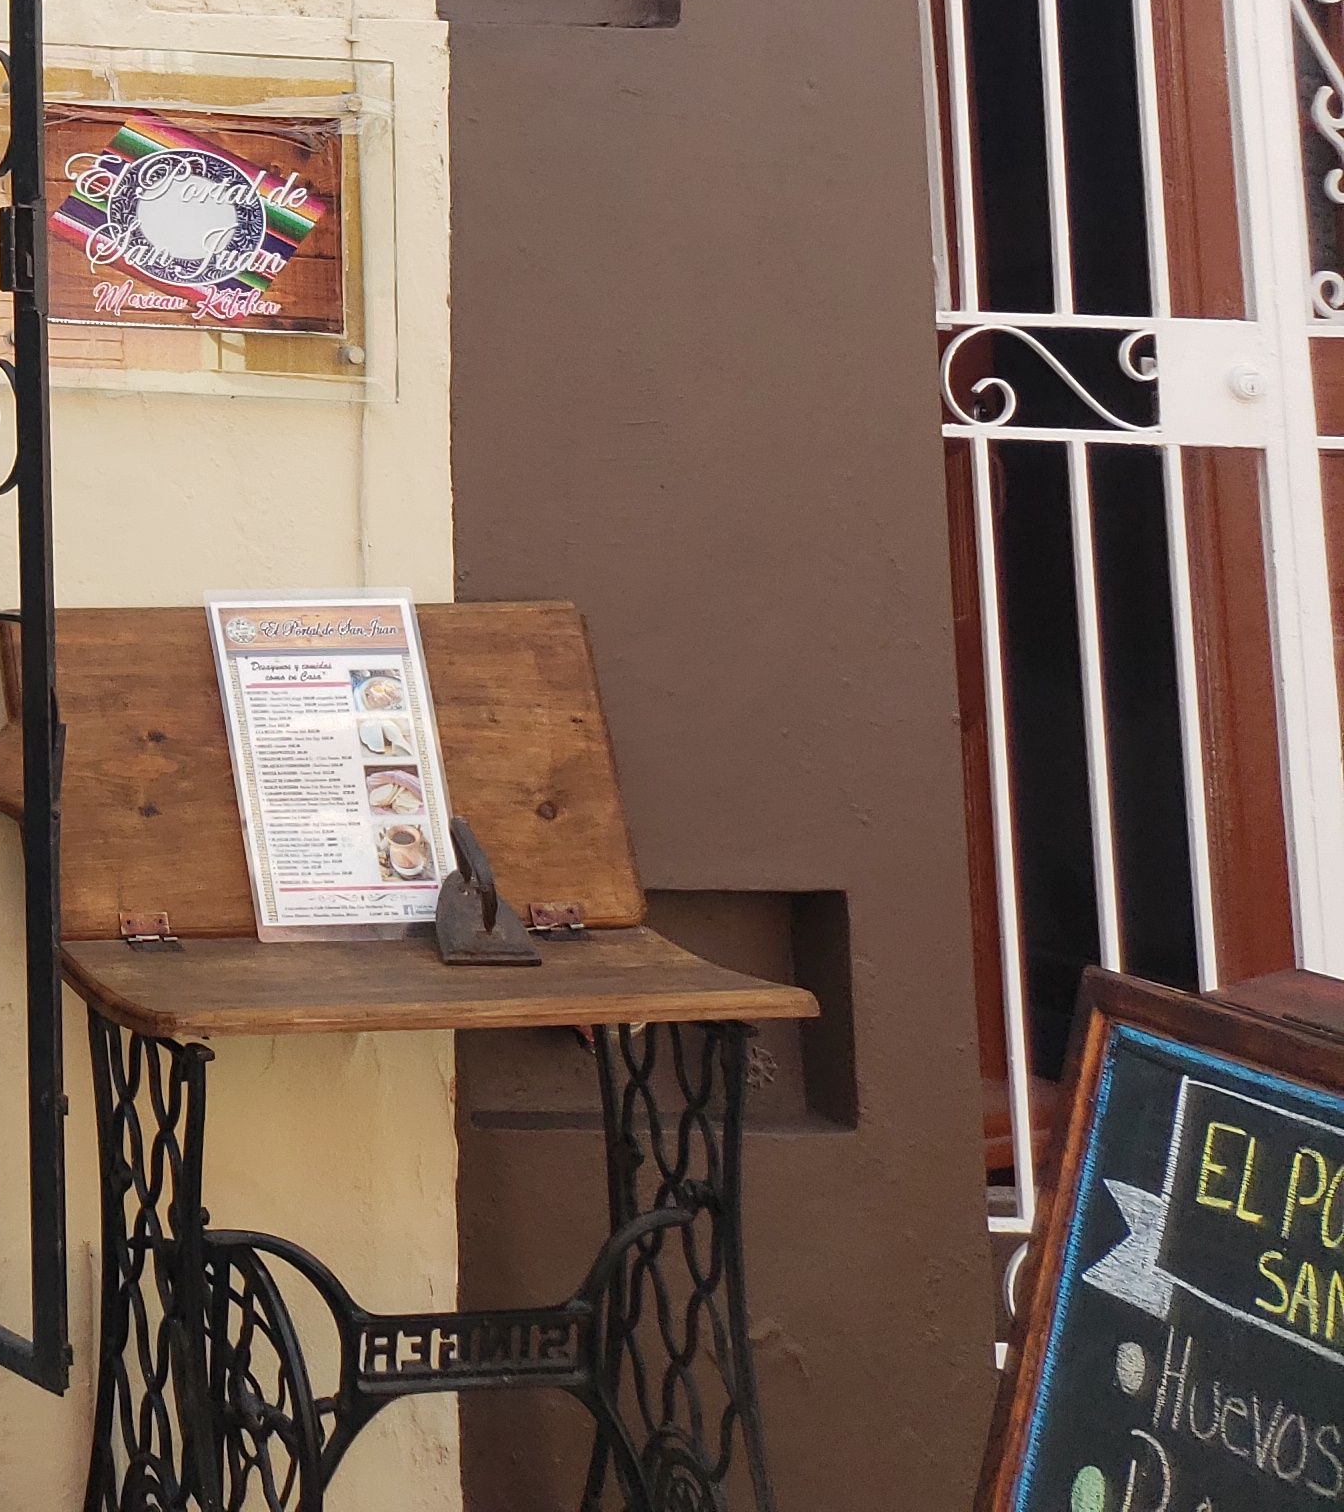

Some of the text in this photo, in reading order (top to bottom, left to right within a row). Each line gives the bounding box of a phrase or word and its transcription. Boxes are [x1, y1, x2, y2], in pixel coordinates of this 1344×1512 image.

[65, 152, 308, 209] El Portal de
[85, 222, 287, 280] San Juan
[93, 279, 282, 321] Mexican Kitchen
[260, 617, 398, 638] El Portal de San Juan
[1196, 1122, 1344, 1250] EL PO
